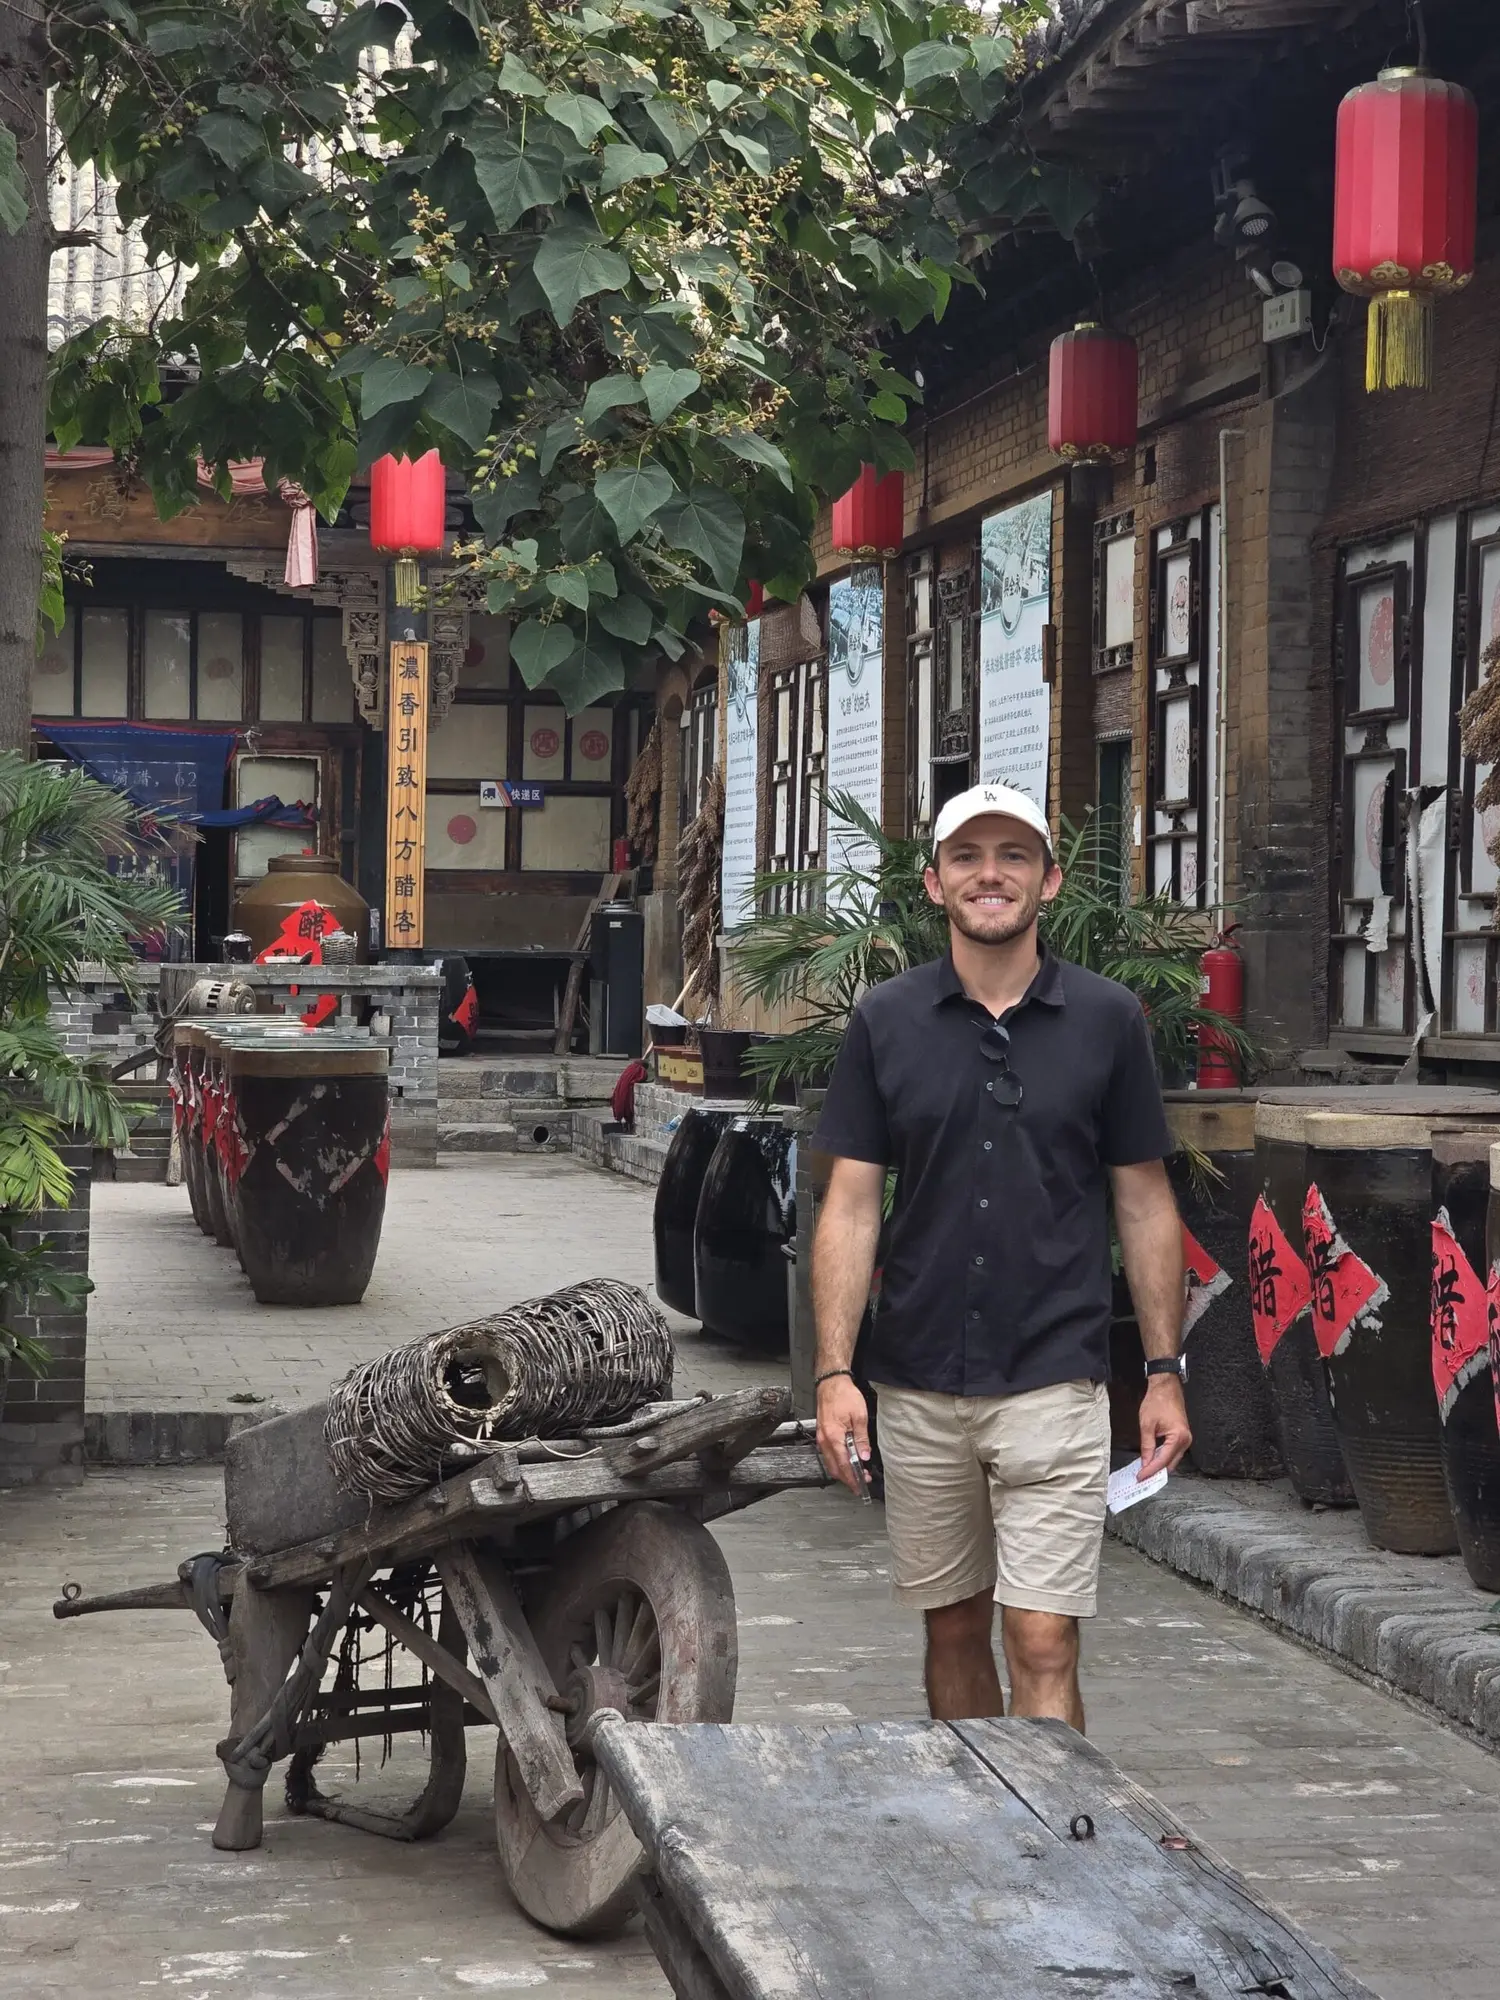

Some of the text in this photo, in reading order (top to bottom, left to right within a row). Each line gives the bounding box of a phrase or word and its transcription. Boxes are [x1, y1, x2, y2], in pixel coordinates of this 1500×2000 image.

[393, 656, 420, 933] 濃香引致八方醋客
[511, 789, 540, 801] 快递区
[984, 791, 997, 802] LA
[299, 909, 327, 941] 醋
